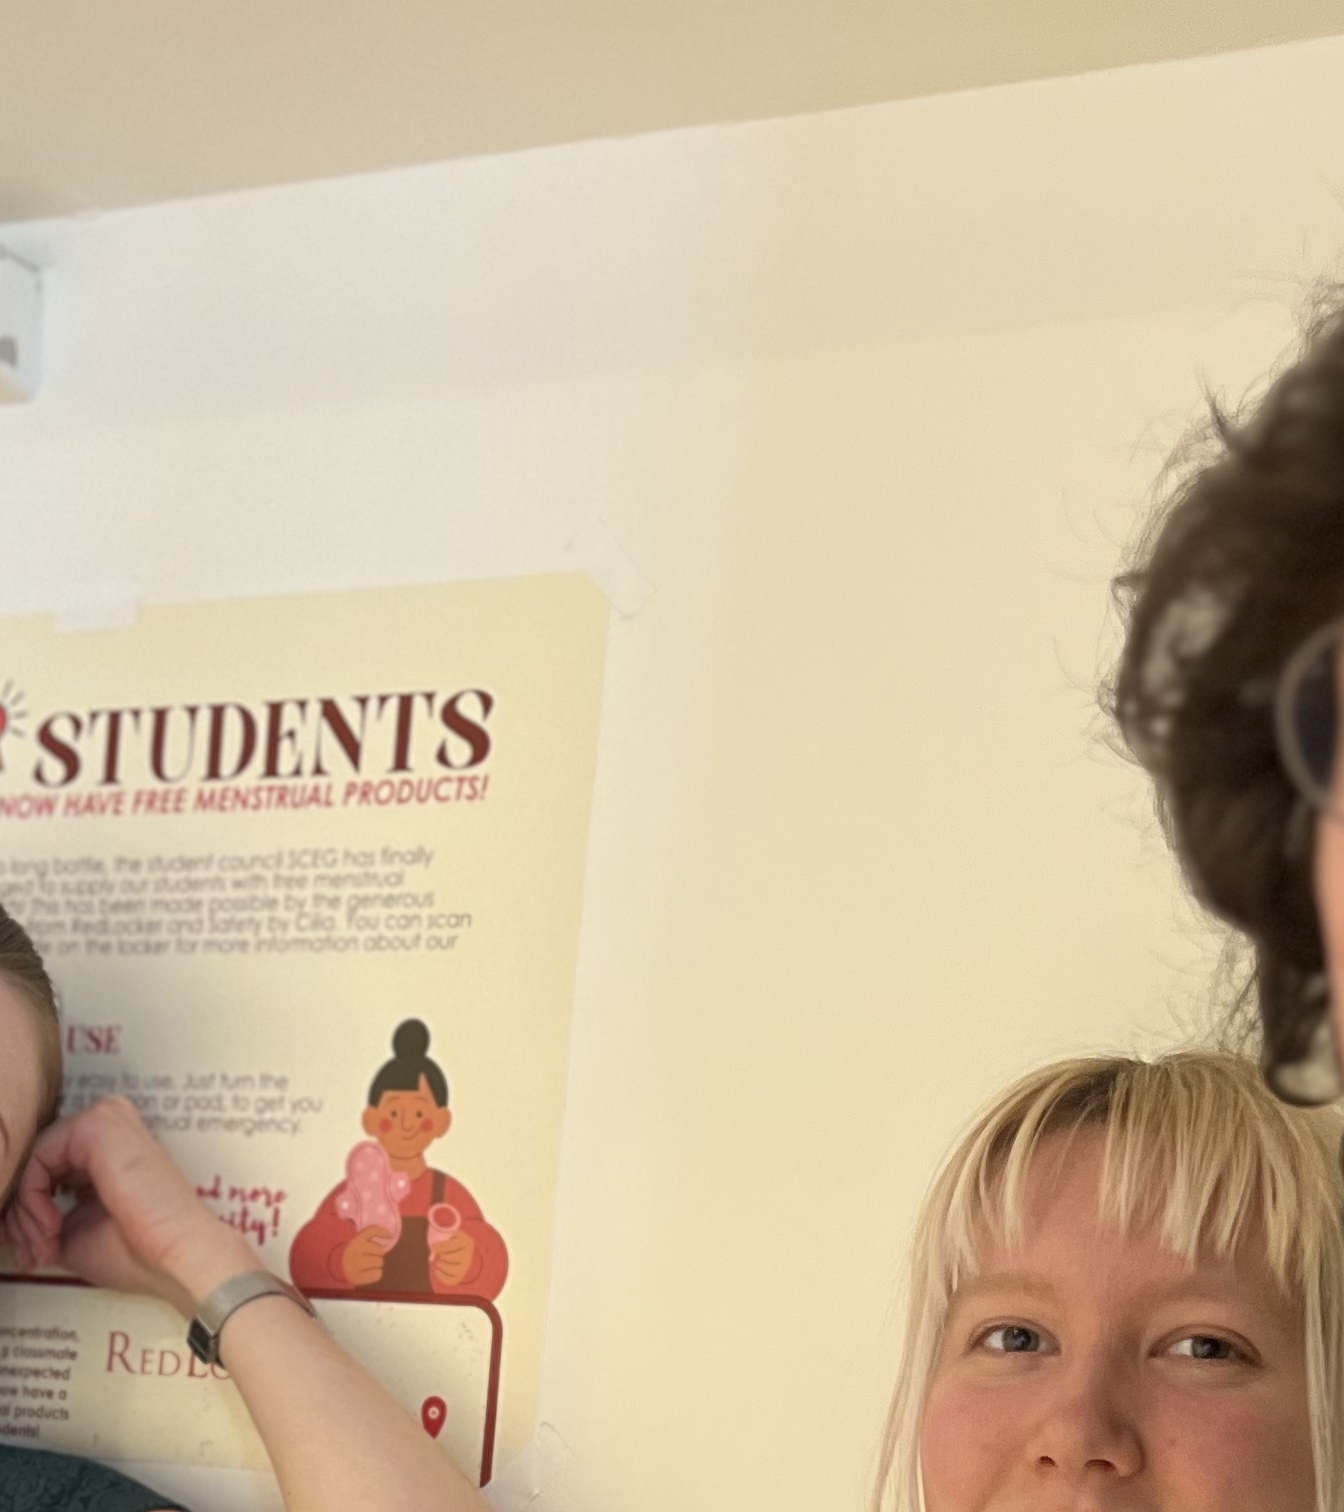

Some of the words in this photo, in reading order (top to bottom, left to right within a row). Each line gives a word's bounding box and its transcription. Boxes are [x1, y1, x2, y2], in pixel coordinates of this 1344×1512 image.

[32, 689, 494, 788] STUDENTS
[62, 790, 125, 817] HAVE
[133, 787, 187, 814] FREE
[194, 783, 333, 813] MENSTRUAL
[343, 775, 490, 806] PRODUCTS!
[114, 855, 142, 874] the
[146, 853, 214, 875] student
[217, 850, 283, 873] council
[343, 847, 377, 867] has
[381, 845, 435, 870] finally
[119, 877, 149, 893] our
[152, 875, 226, 893] students
[272, 871, 308, 890] free
[312, 869, 404, 889] menstrual
[150, 895, 204, 914] made
[208, 893, 279, 918] possible
[283, 894, 305, 914] by
[311, 892, 342, 910] the
[346, 890, 435, 914] generous
[166, 915, 204, 935] and
[345, 908, 380, 932] You
[383, 912, 423, 931] can
[425, 911, 472, 931] scan
[56, 938, 80, 956] on
[83, 937, 114, 956] the
[116, 936, 172, 956] locker
[174, 936, 200, 955] for
[202, 936, 249, 954] more
[254, 934, 359, 954] information
[362, 931, 422, 952] about
[425, 932, 459, 951] our
[66, 1024, 123, 1055] USE
[181, 1071, 216, 1091] Just
[219, 1070, 255, 1090] turn
[258, 1070, 290, 1090] the
[231, 1092, 251, 1111] to
[253, 1092, 286, 1115] get
[291, 1097, 324, 1116] you
[12, 1346, 78, 1361] classmate
[21, 1385, 54, 1401] have
[58, 1389, 68, 1401] a
[13, 1404, 70, 1422] products
